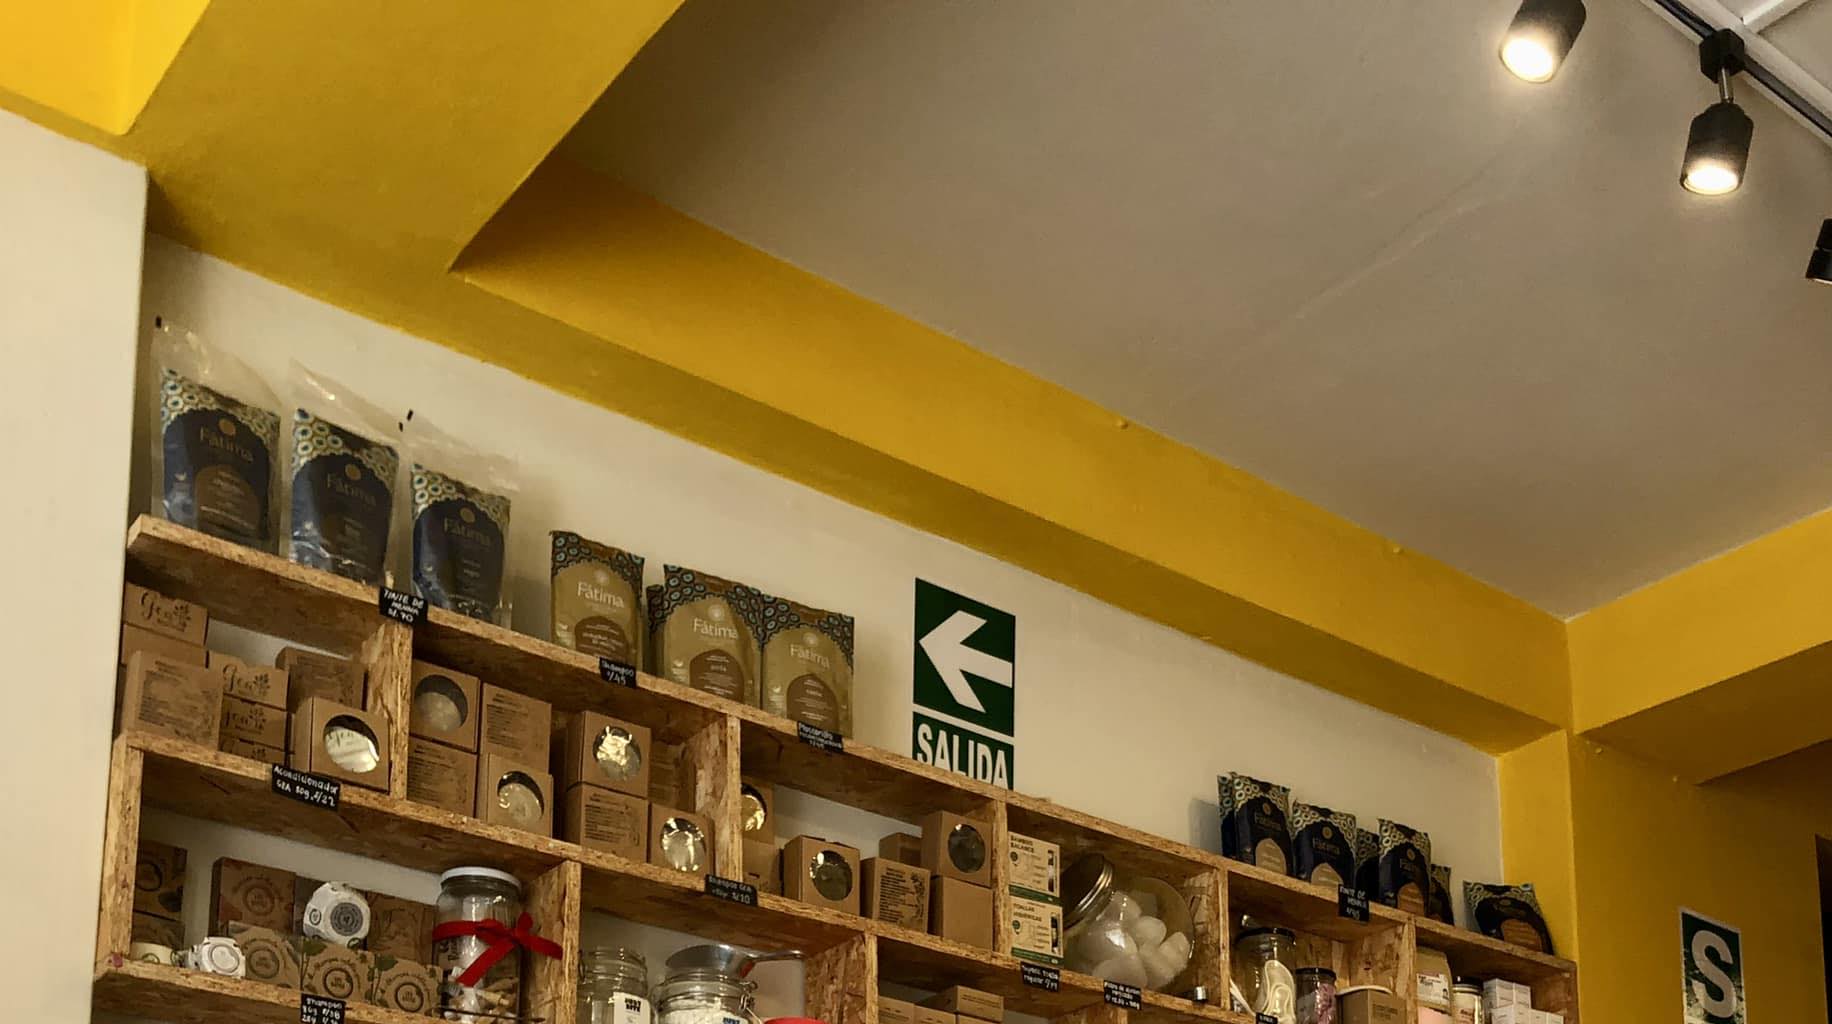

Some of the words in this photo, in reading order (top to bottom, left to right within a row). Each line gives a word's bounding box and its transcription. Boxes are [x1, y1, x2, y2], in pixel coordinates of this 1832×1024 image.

[577, 581, 625, 608] Fátima
[693, 618, 738, 640] Fátima
[790, 644, 830, 669] Fátima
[917, 723, 1009, 791] SALIDA
[1691, 929, 1737, 1019] S
